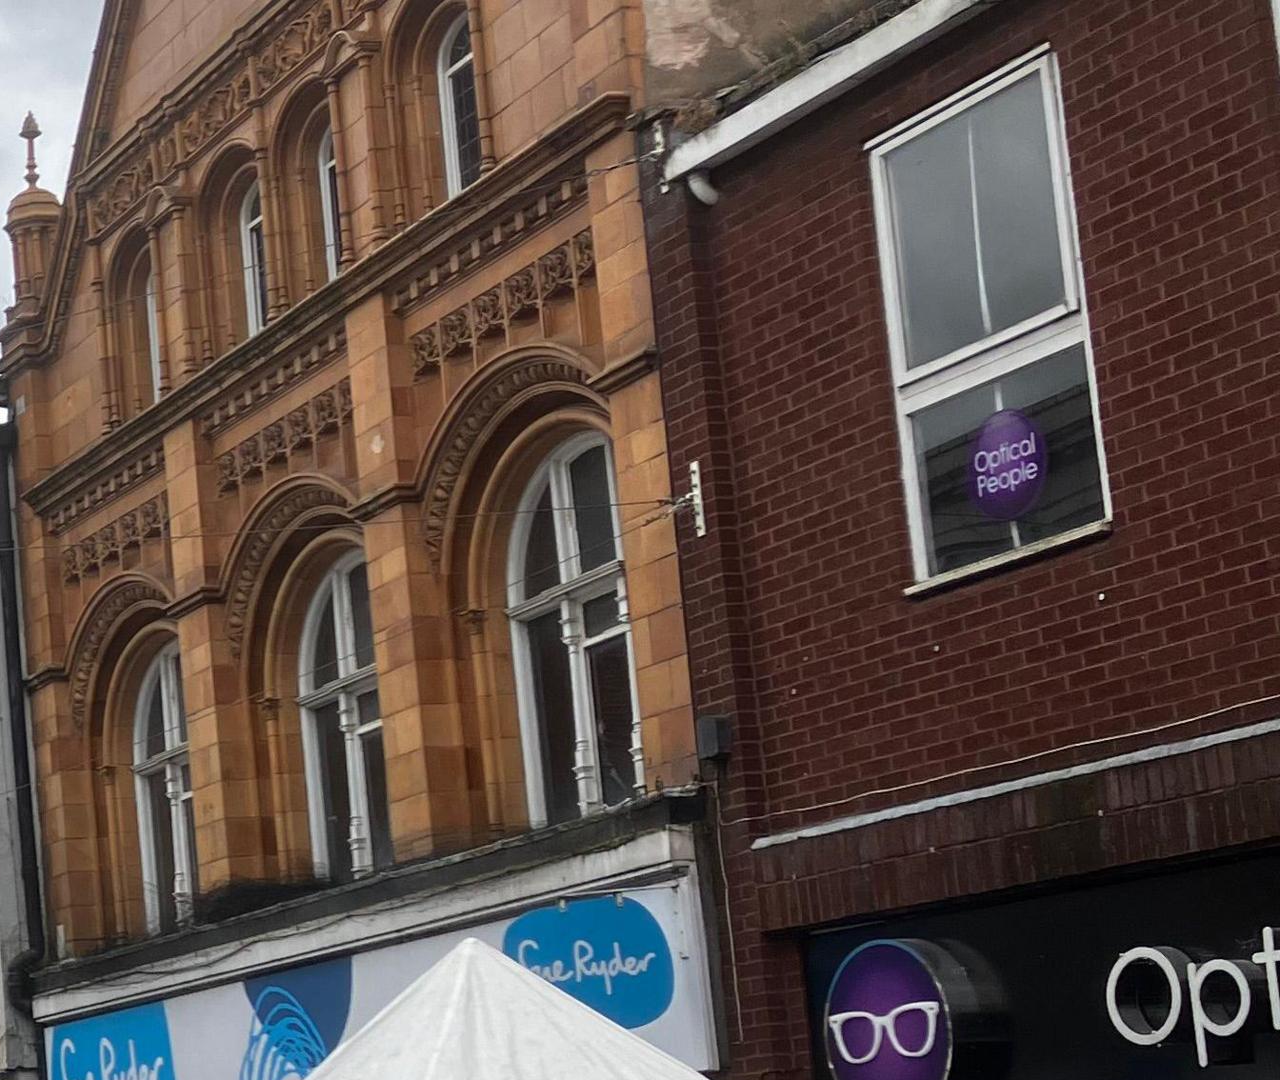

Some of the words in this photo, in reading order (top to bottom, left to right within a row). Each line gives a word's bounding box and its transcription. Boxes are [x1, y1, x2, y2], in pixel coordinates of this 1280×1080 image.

[974, 431, 1036, 474] Optical
[977, 461, 1038, 497] People
[573, 939, 656, 995] Ryder
[1106, 926, 1280, 1068] Opt
